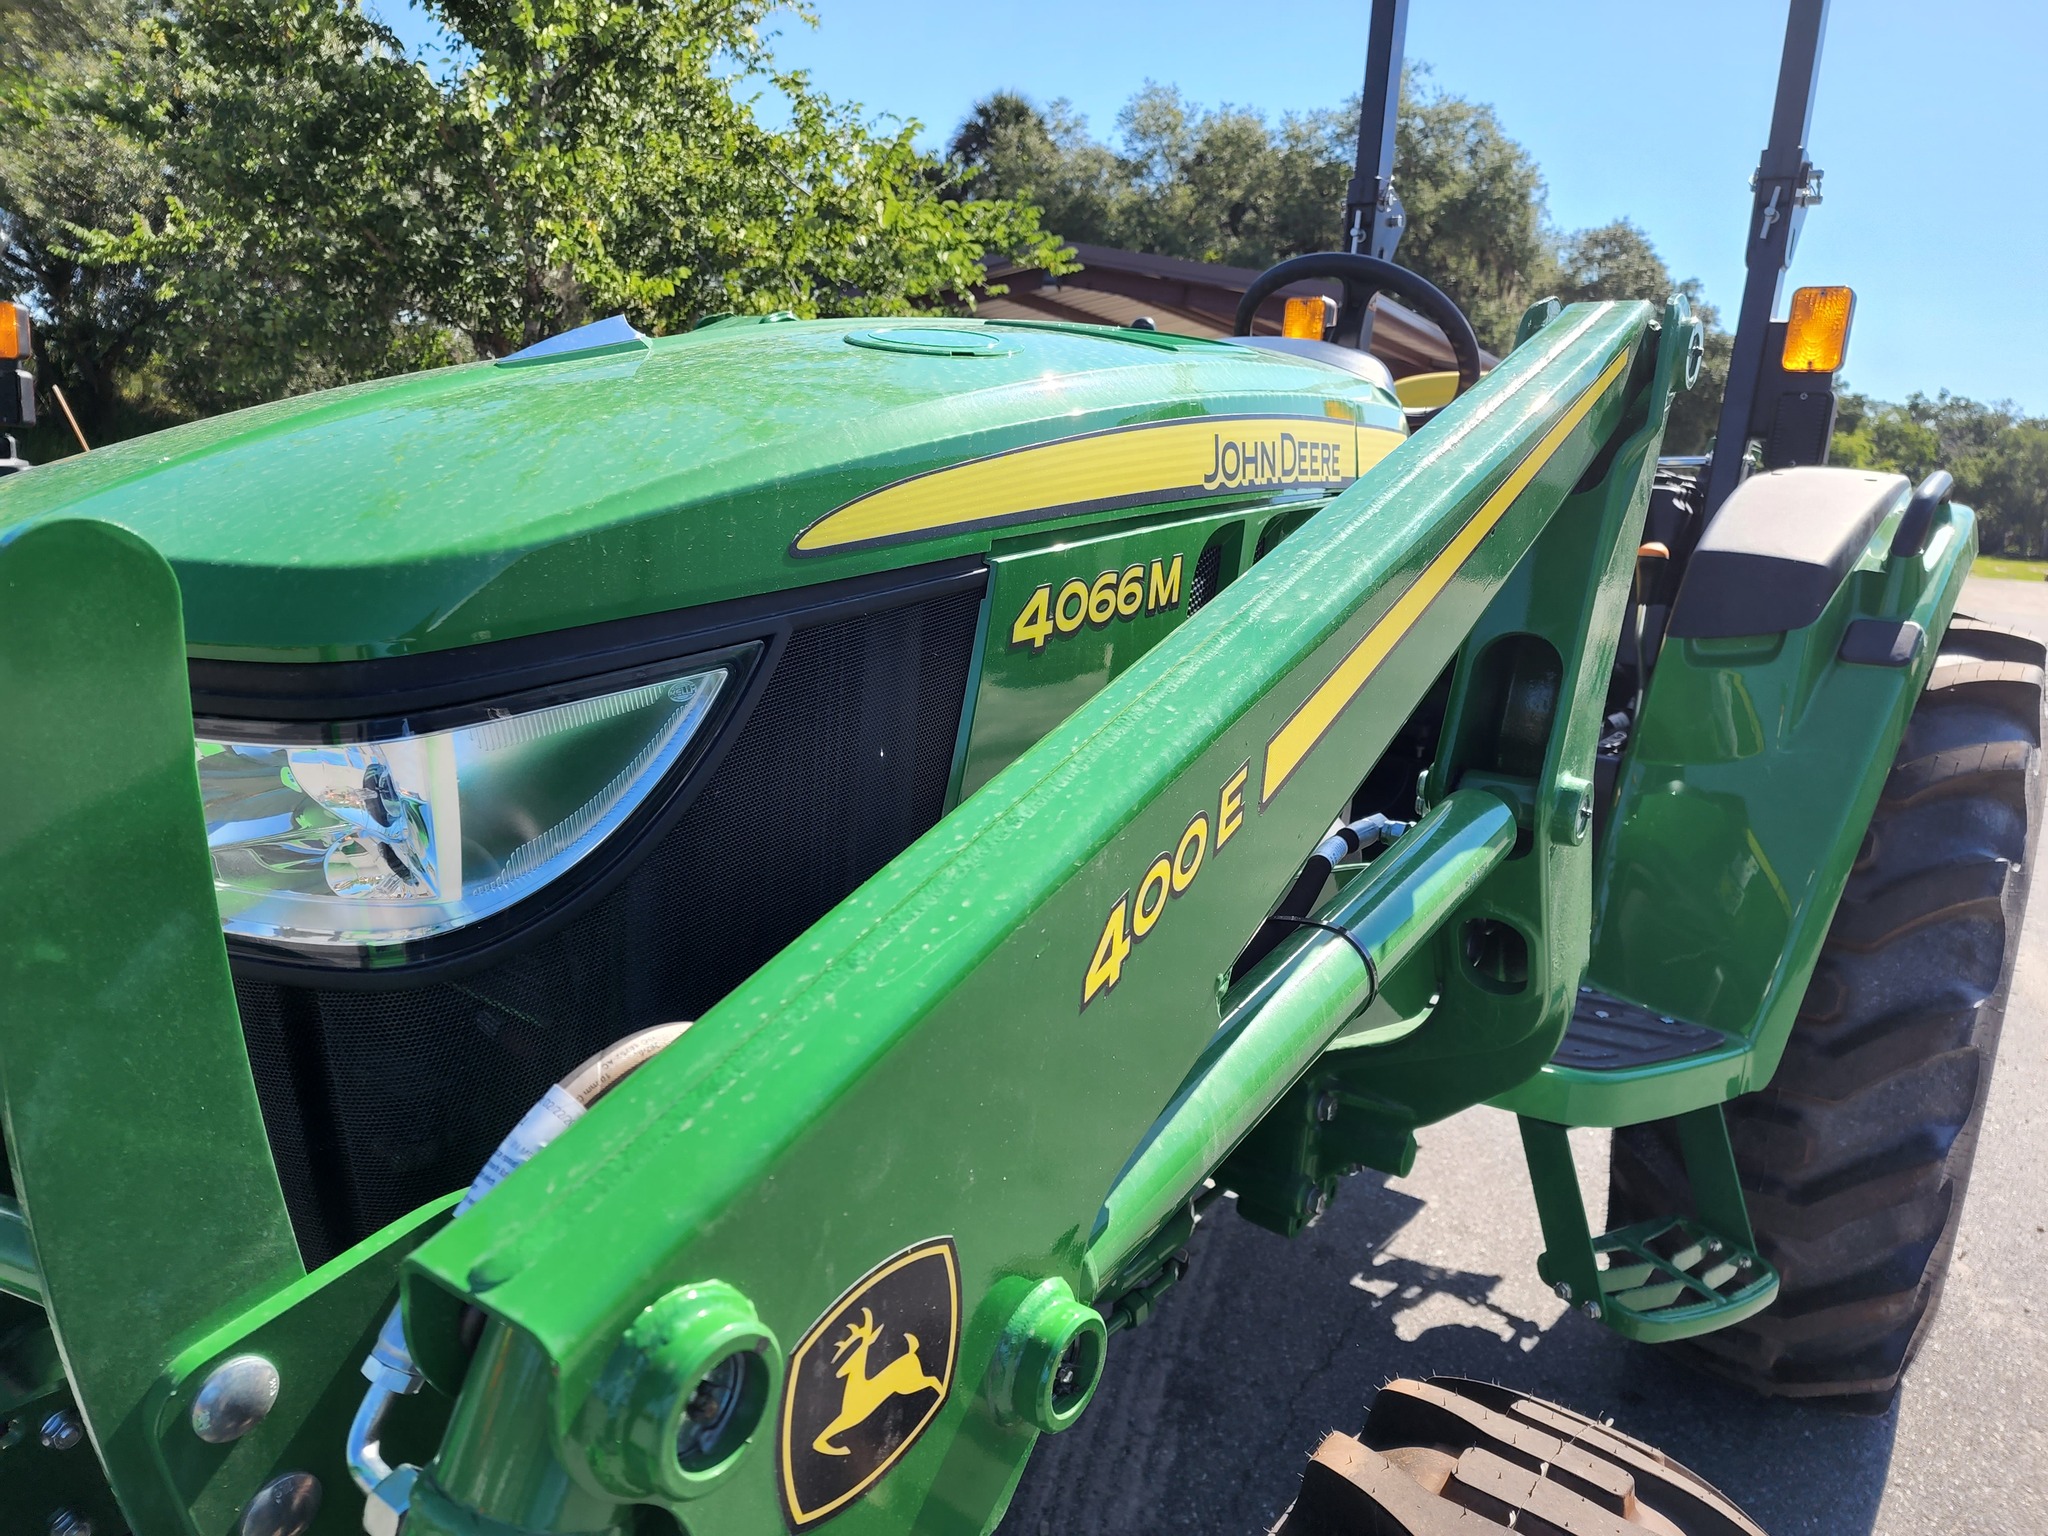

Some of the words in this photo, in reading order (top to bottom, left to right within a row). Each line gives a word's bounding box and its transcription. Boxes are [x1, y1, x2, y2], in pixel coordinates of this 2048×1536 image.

[1203, 433, 1276, 484] JOHN
[1280, 432, 1341, 477] DEERE
[1010, 553, 1185, 653] 4066M
